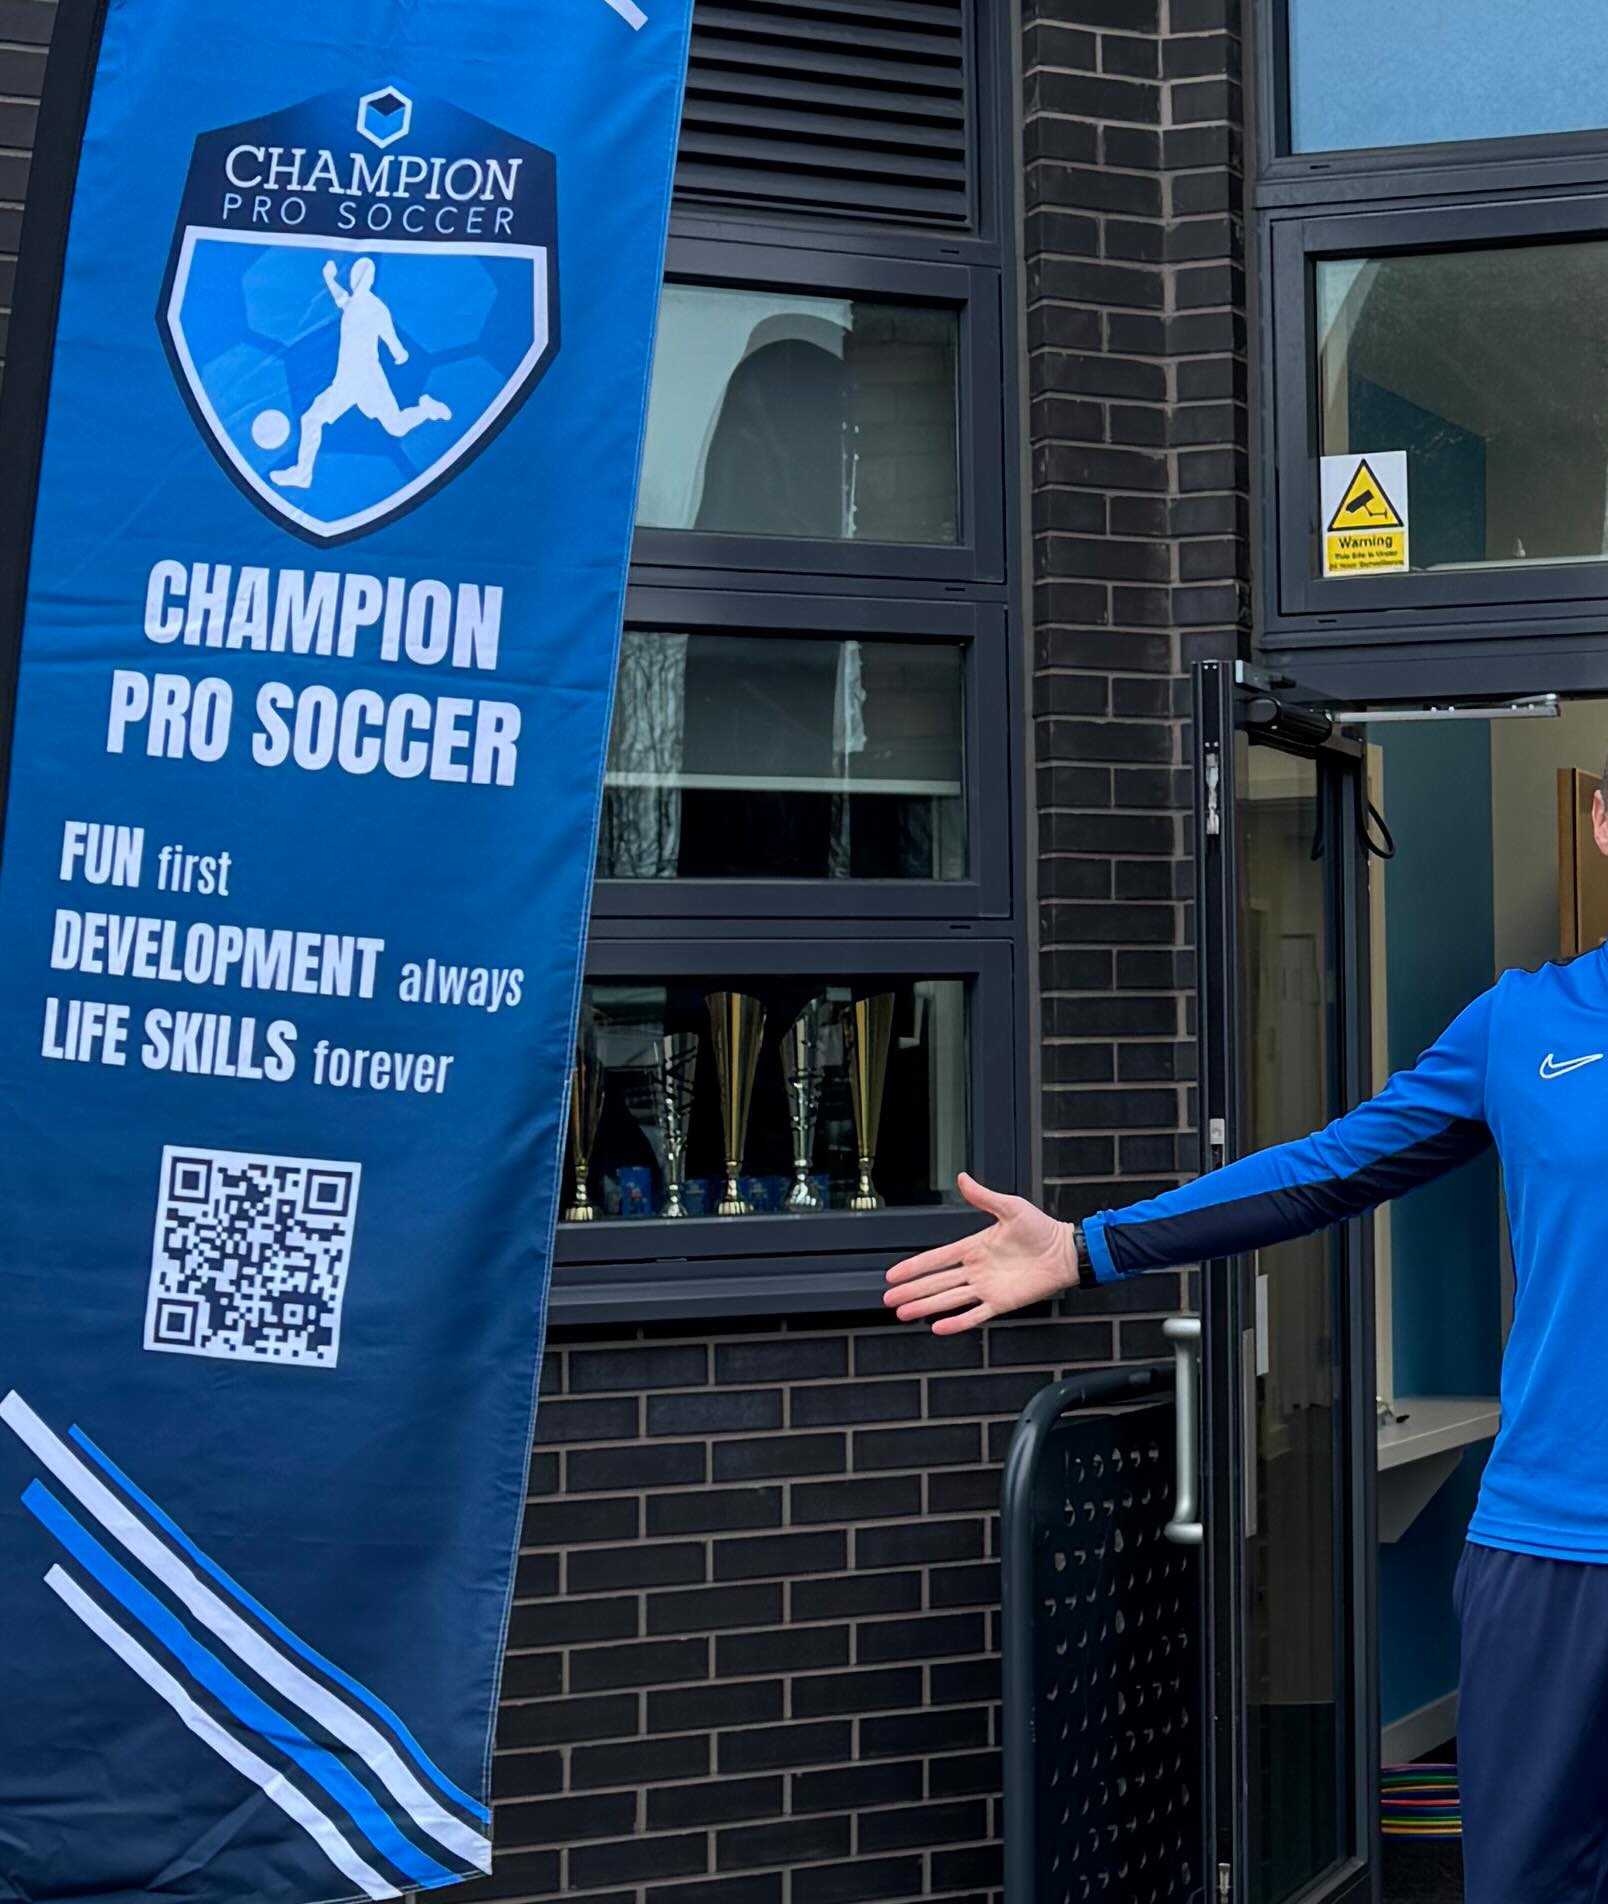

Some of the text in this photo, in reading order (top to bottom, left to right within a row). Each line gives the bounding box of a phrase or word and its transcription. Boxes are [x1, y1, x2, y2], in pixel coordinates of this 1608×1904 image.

[223, 193, 514, 235] PRO SOCCER
[224, 144, 523, 201] CHAMPION
[1338, 536, 1393, 549] Warning
[143, 559, 503, 670] CHAMPION
[106, 669, 522, 787] PRO SOCCER
[59, 821, 232, 896] FUN first
[50, 909, 525, 1013] DEVELOPMENT always
[41, 997, 454, 1094] LIFE SKILLS forever
